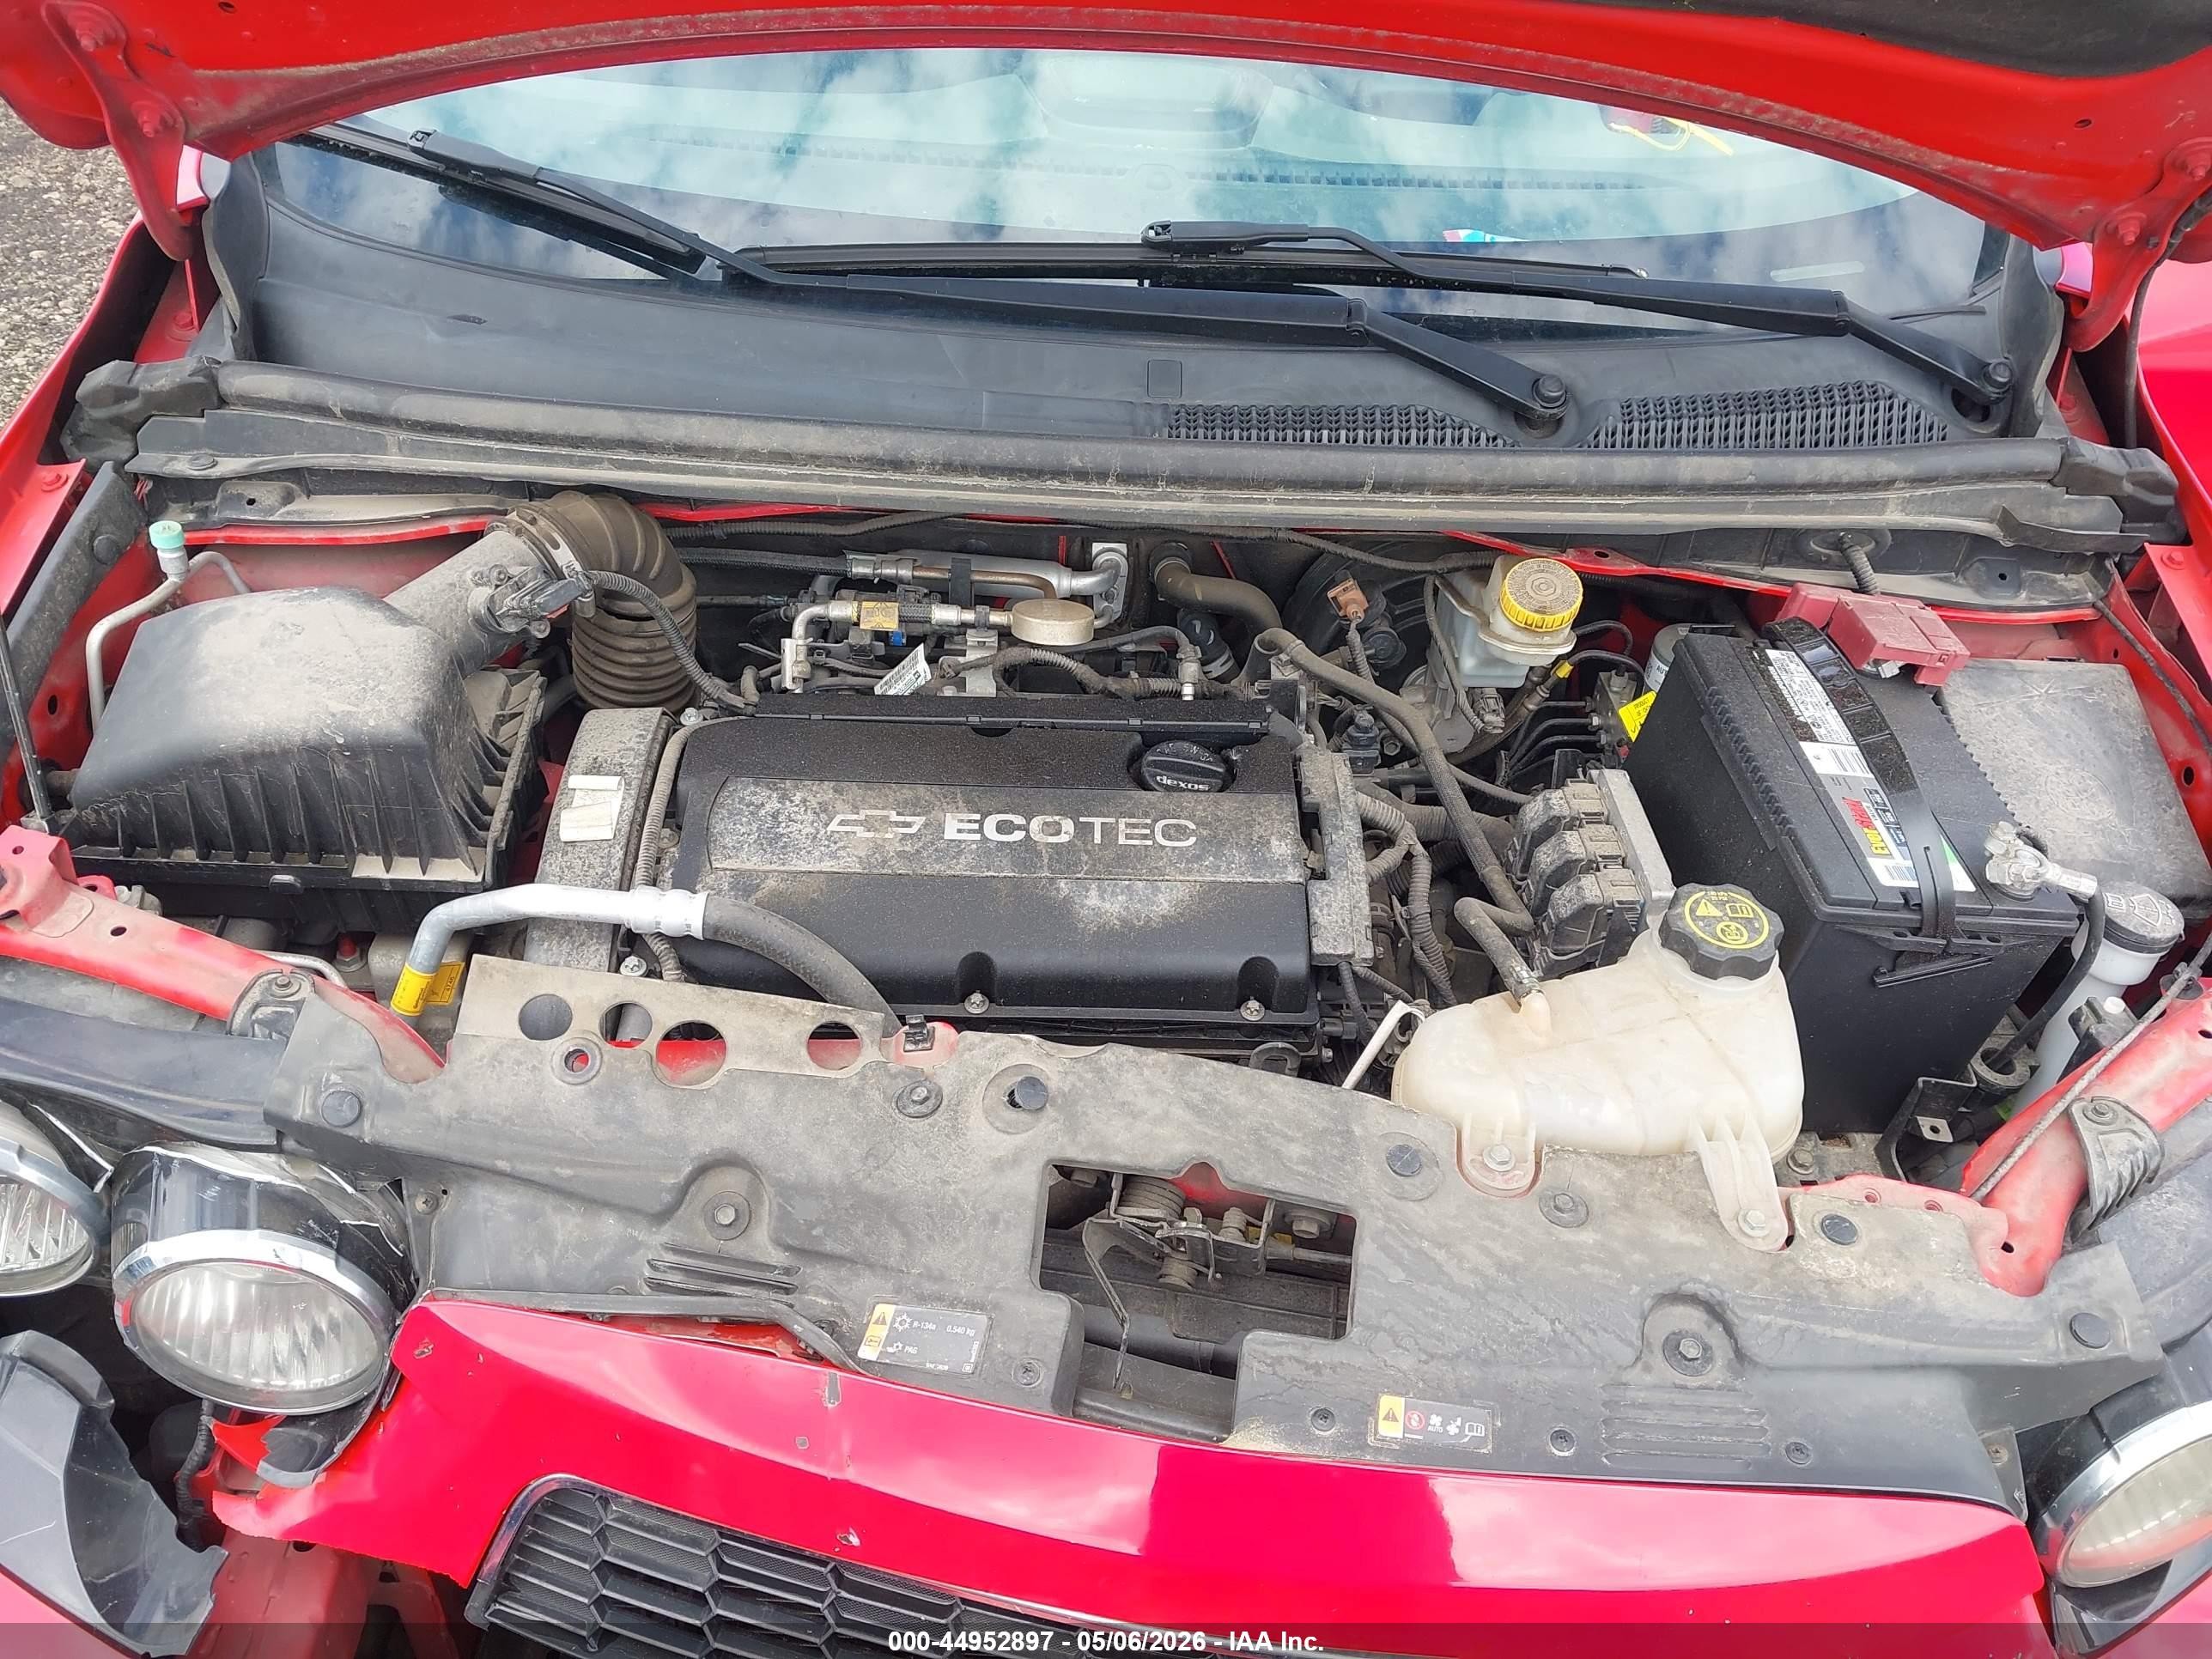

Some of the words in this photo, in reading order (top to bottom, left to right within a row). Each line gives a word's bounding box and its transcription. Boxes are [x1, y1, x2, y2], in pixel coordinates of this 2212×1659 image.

[1156, 775, 1209, 791] dexos
[944, 812, 1197, 847] ECOTEC
[912, 1321, 937, 1330] R-134a
[966, 1327, 976, 1336] kg
